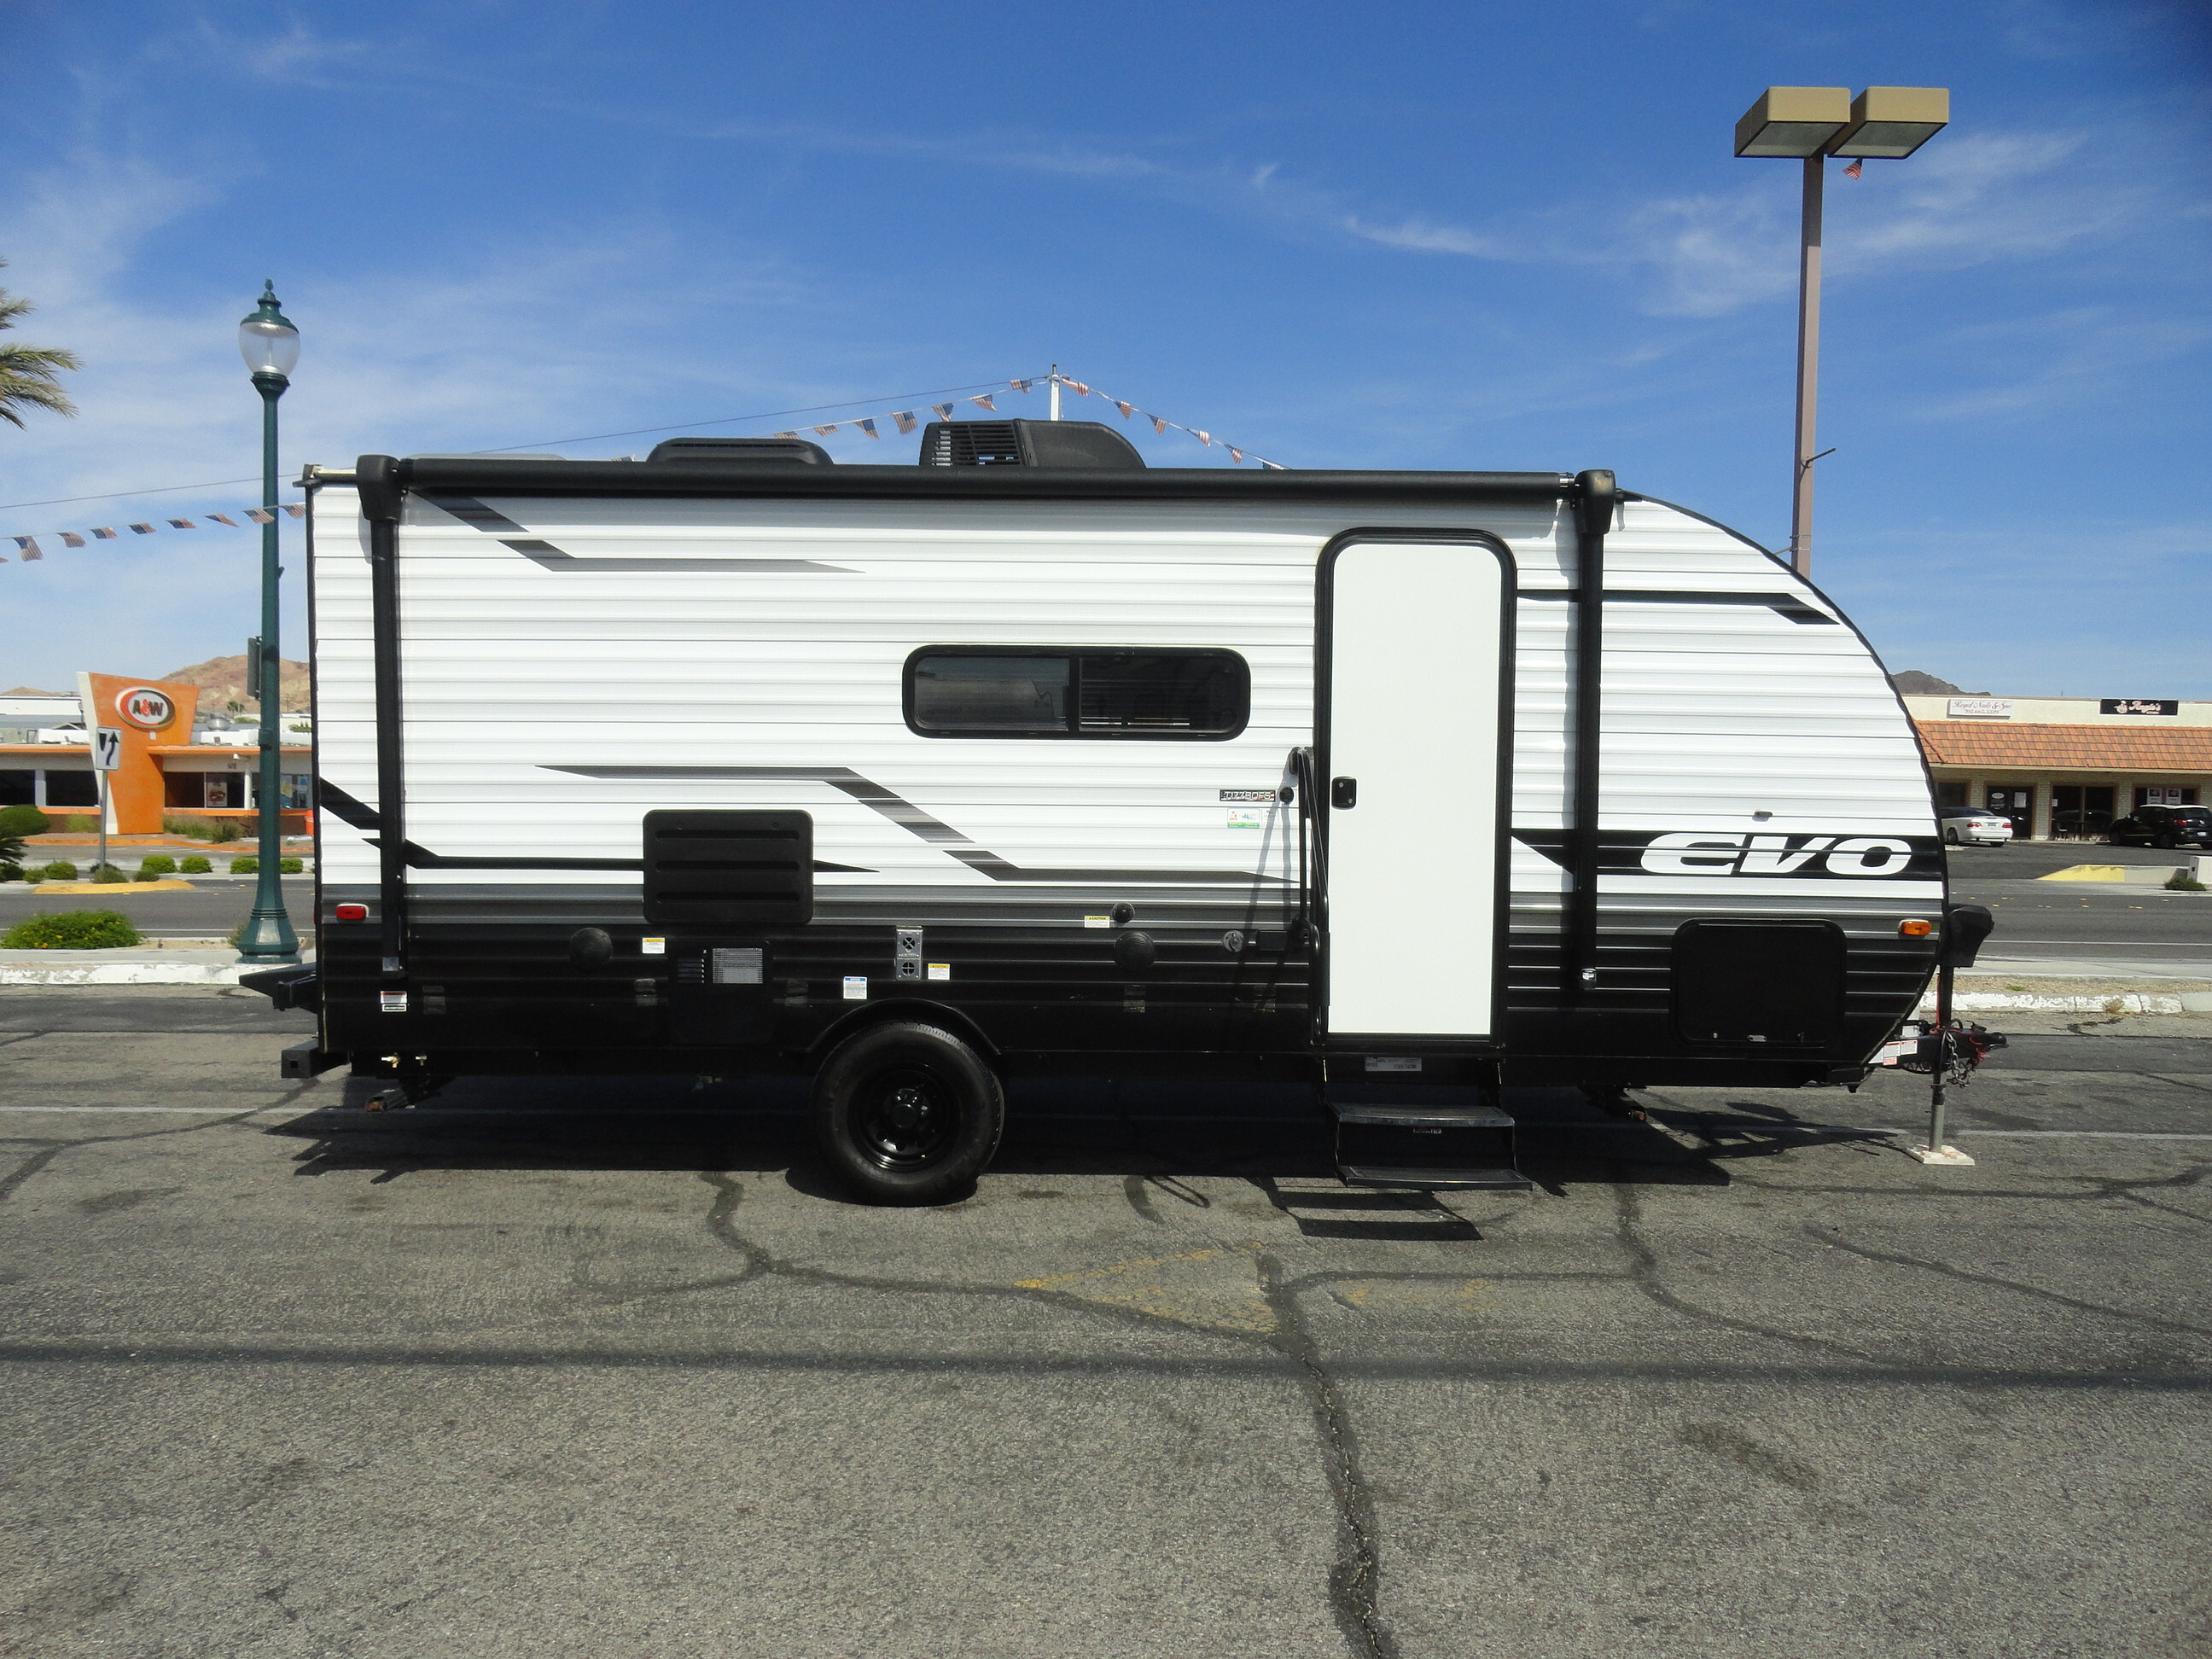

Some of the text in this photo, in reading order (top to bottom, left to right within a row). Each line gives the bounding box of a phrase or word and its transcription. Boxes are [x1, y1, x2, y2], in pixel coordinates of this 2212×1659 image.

[132, 698, 163, 717] A&W
[1953, 700, 1974, 709] Royal
[1640, 832, 1912, 876] EVO
